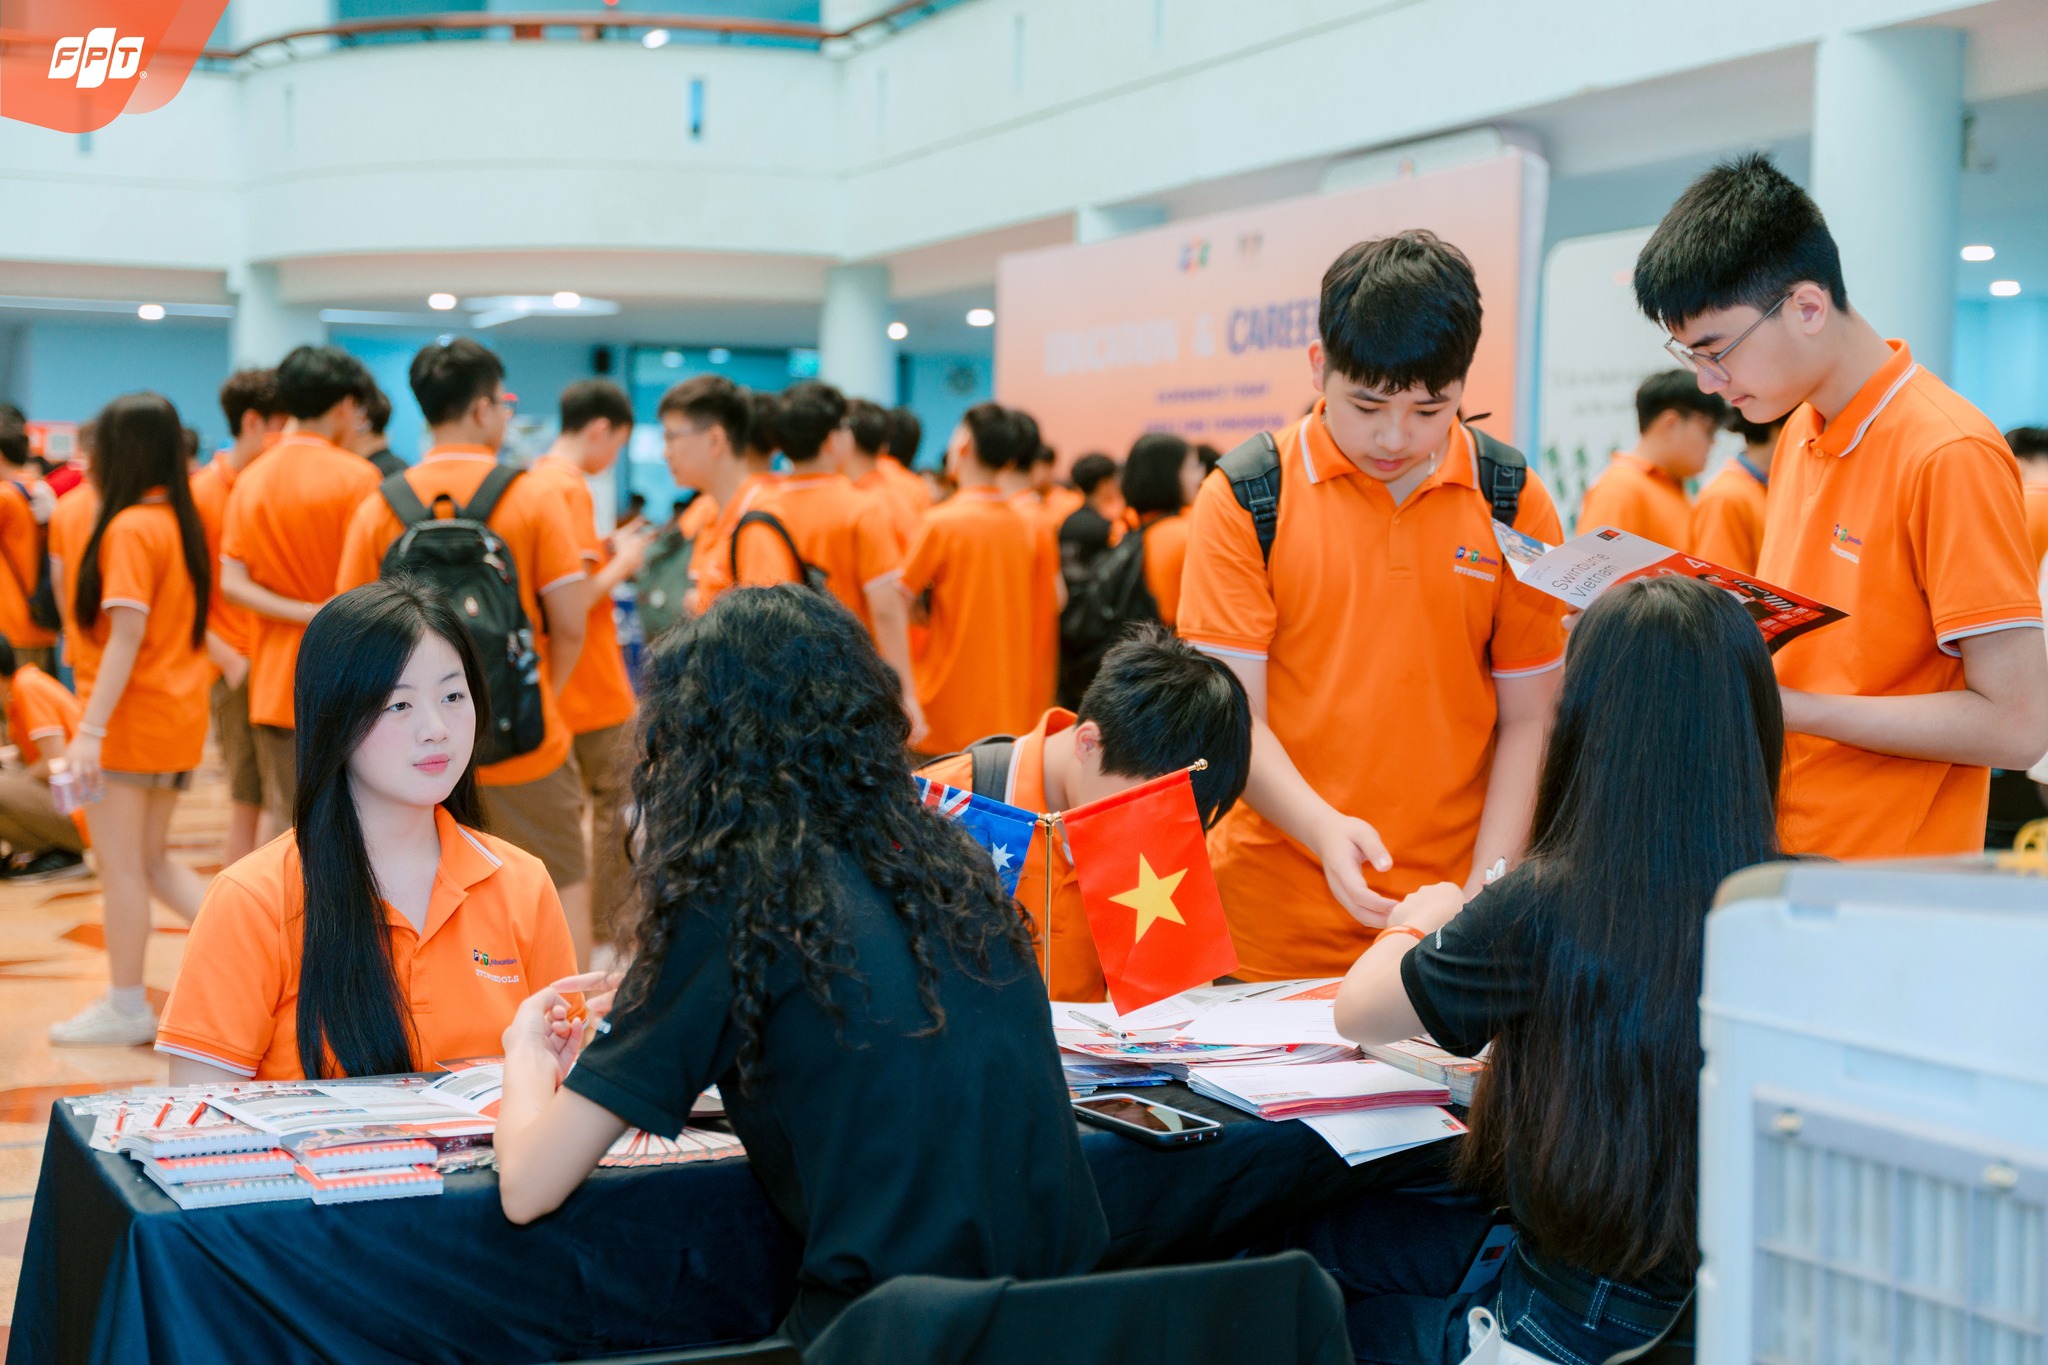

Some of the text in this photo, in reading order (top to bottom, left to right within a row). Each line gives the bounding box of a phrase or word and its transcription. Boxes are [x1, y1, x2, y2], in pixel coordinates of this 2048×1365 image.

[1228, 299, 1321, 354] CAREE
[1551, 553, 1610, 591] Swinburne
[1570, 564, 1620, 598] Vietnam
